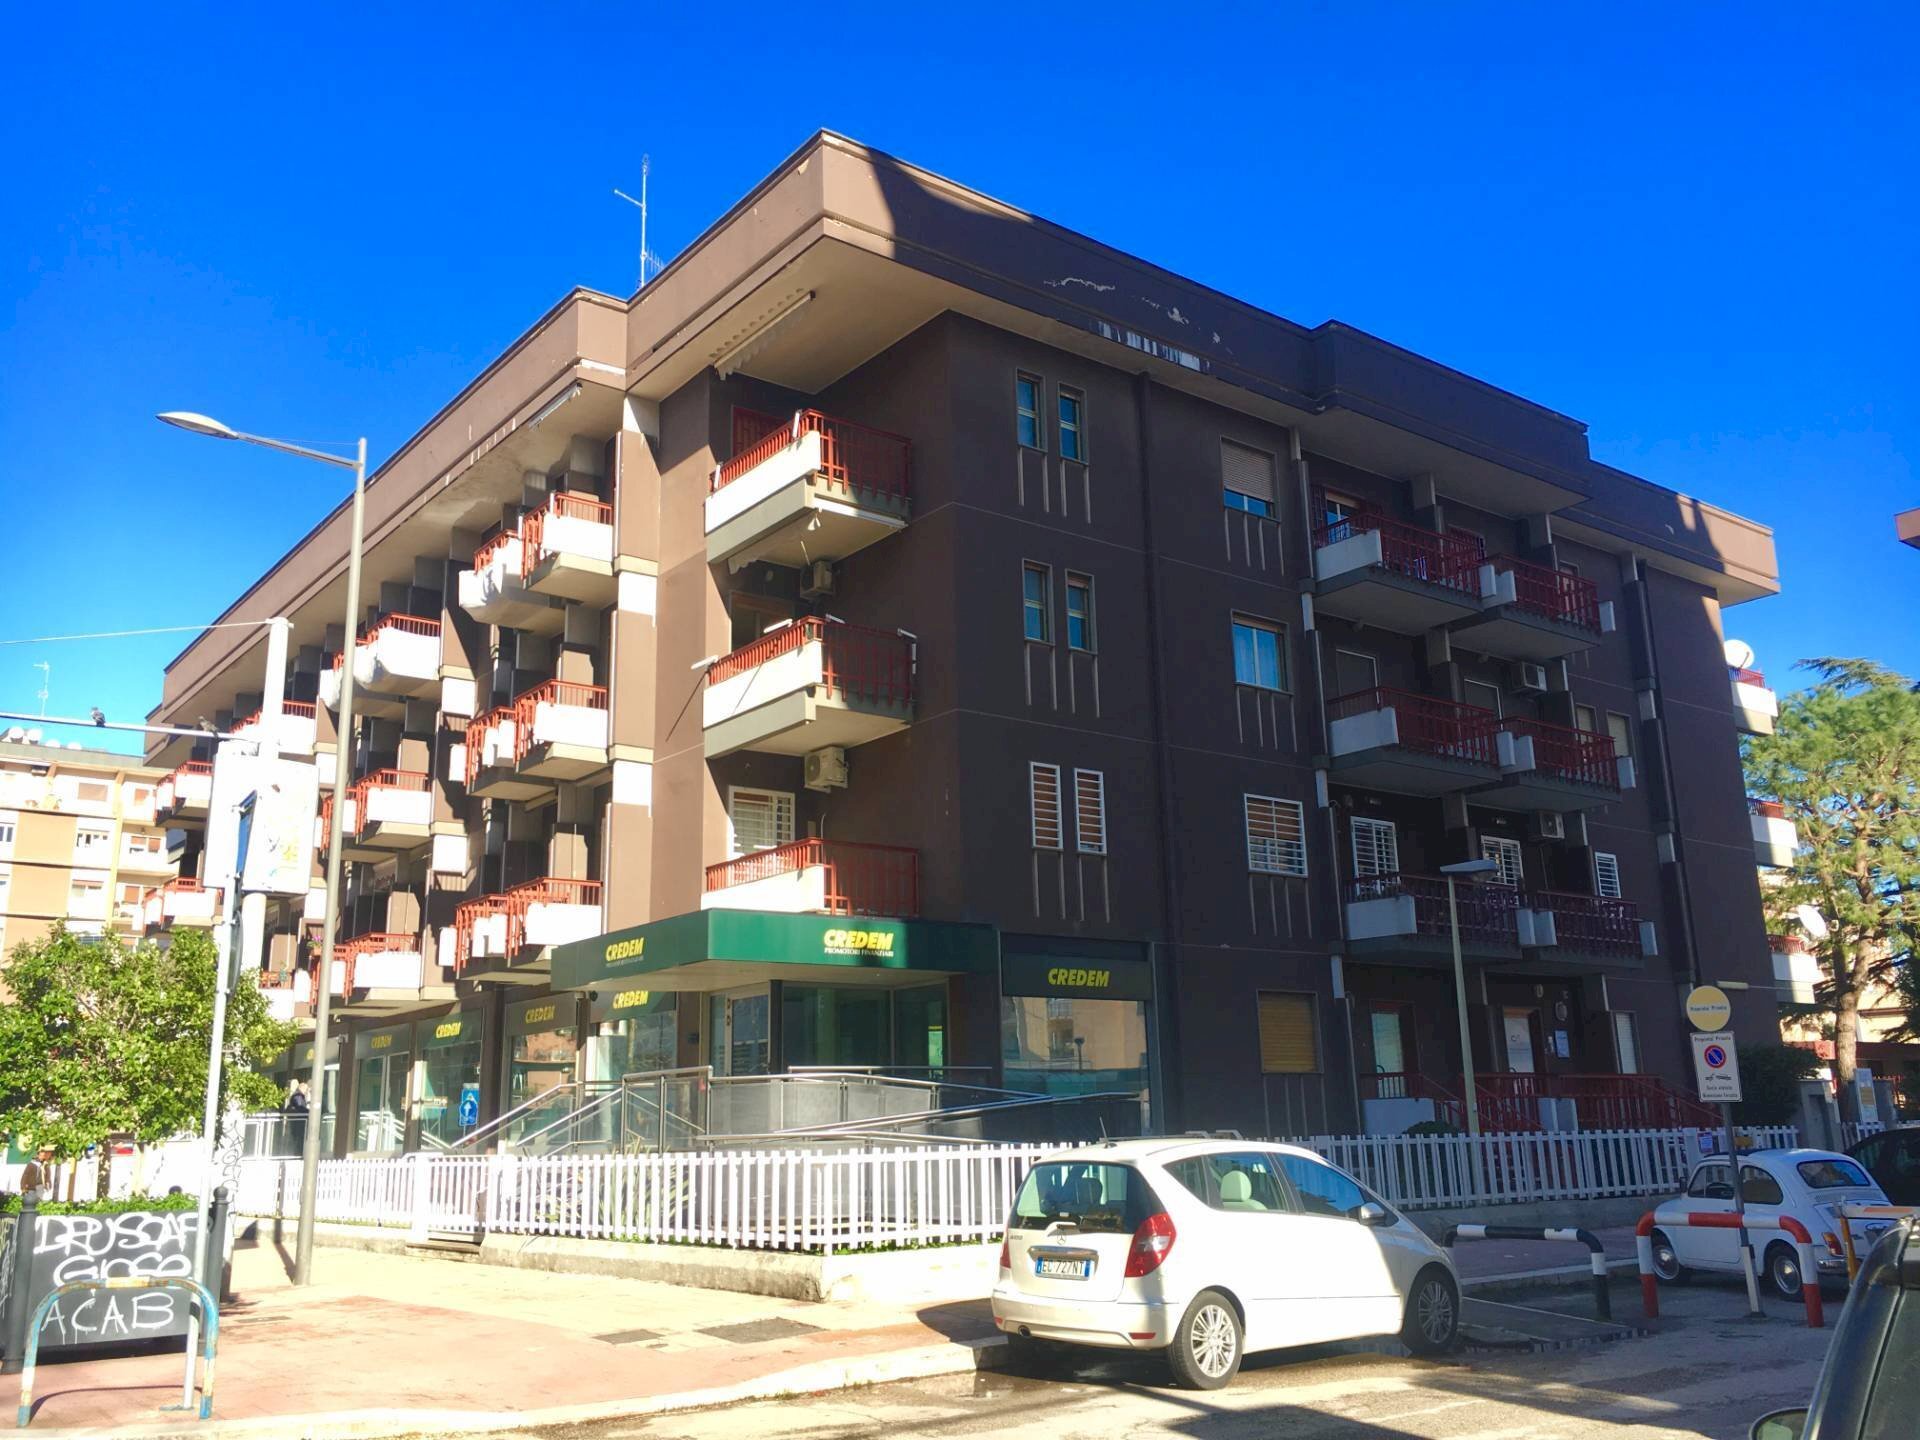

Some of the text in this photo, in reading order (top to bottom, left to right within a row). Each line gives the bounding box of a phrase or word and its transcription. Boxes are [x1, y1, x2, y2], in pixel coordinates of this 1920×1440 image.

[605, 936, 645, 961] CREDEM
[824, 929, 895, 950] CREDEM
[824, 947, 860, 955] PROMOTORI
[1047, 967, 1110, 987] CREDEM
[612, 990, 649, 1009] CREDEM
[525, 1005, 556, 1024] CREDEM
[435, 1021, 462, 1038] CREDEM
